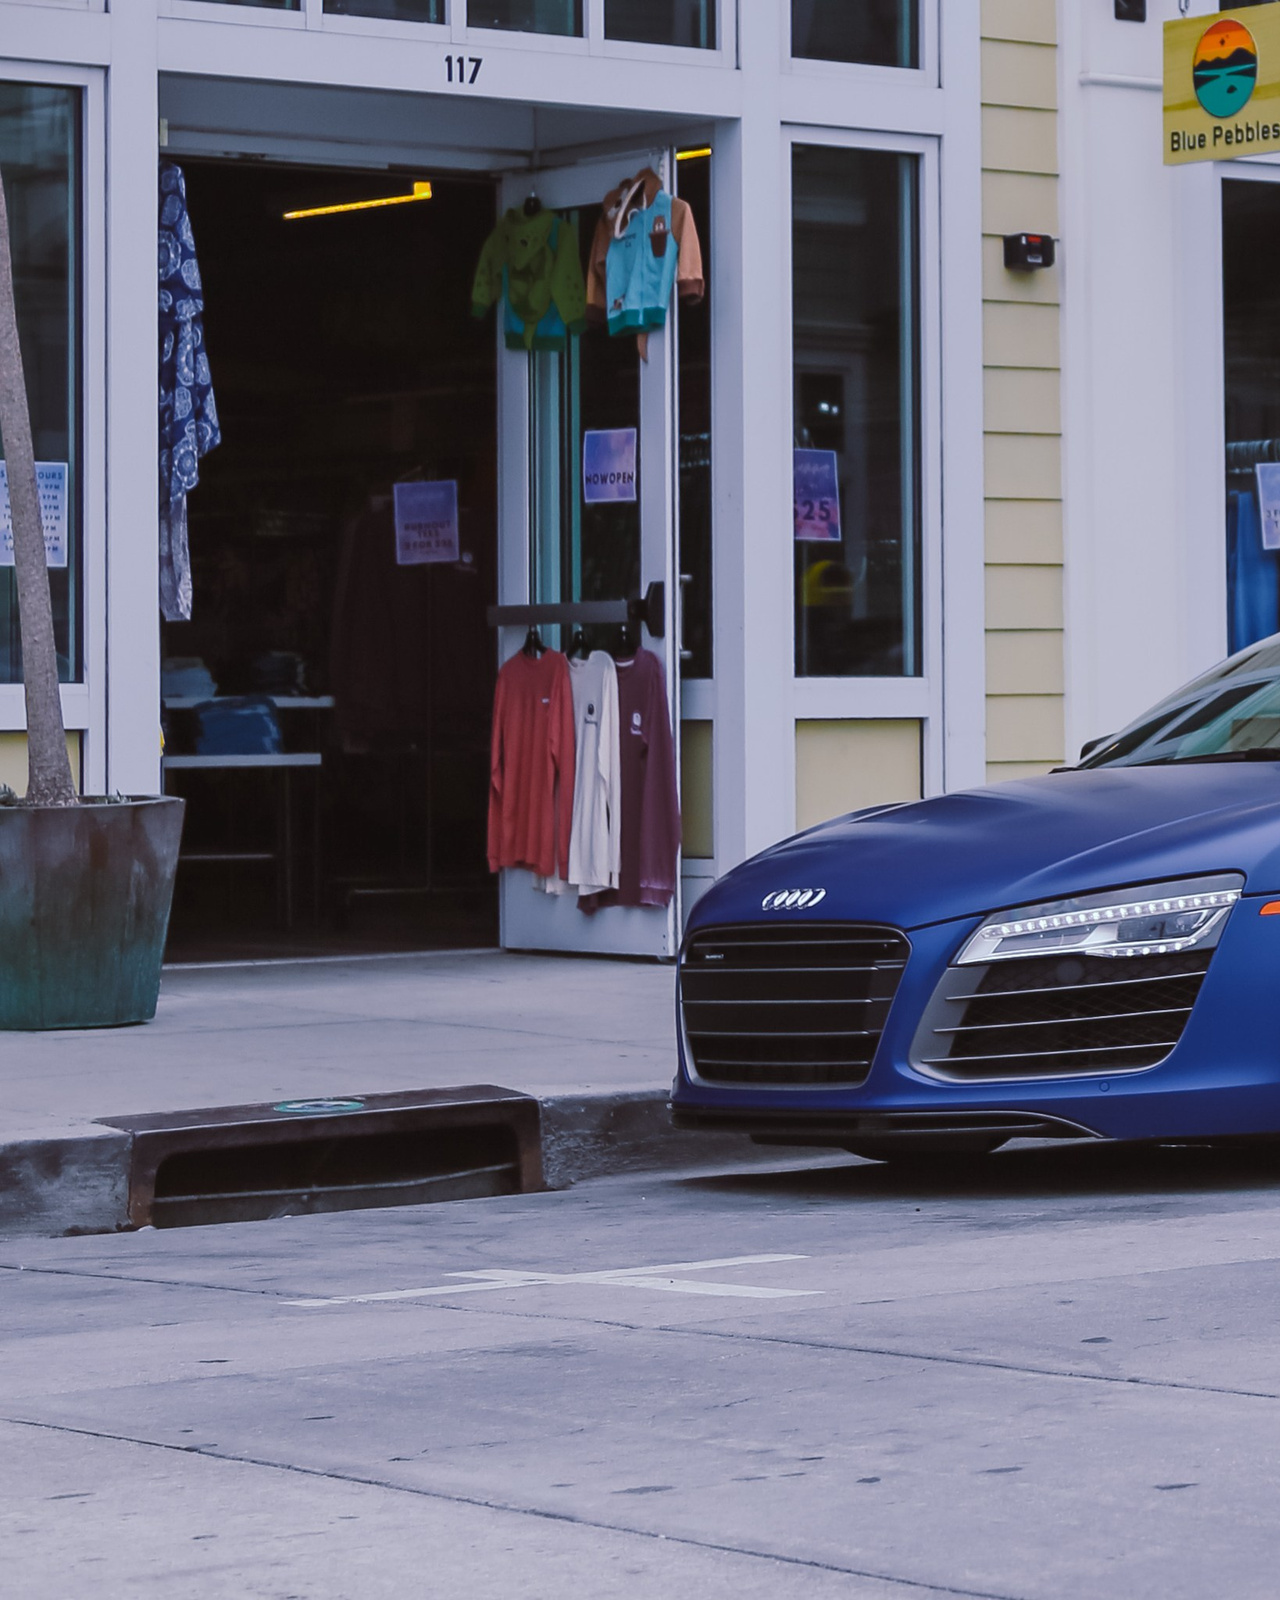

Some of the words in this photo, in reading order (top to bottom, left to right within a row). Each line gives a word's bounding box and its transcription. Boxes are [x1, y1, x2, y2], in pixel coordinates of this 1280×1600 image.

[444, 54, 483, 84] 117
[1170, 130, 1206, 152] Blue
[1213, 120, 1280, 147] Pebbles
[38, 471, 62, 480] OURS
